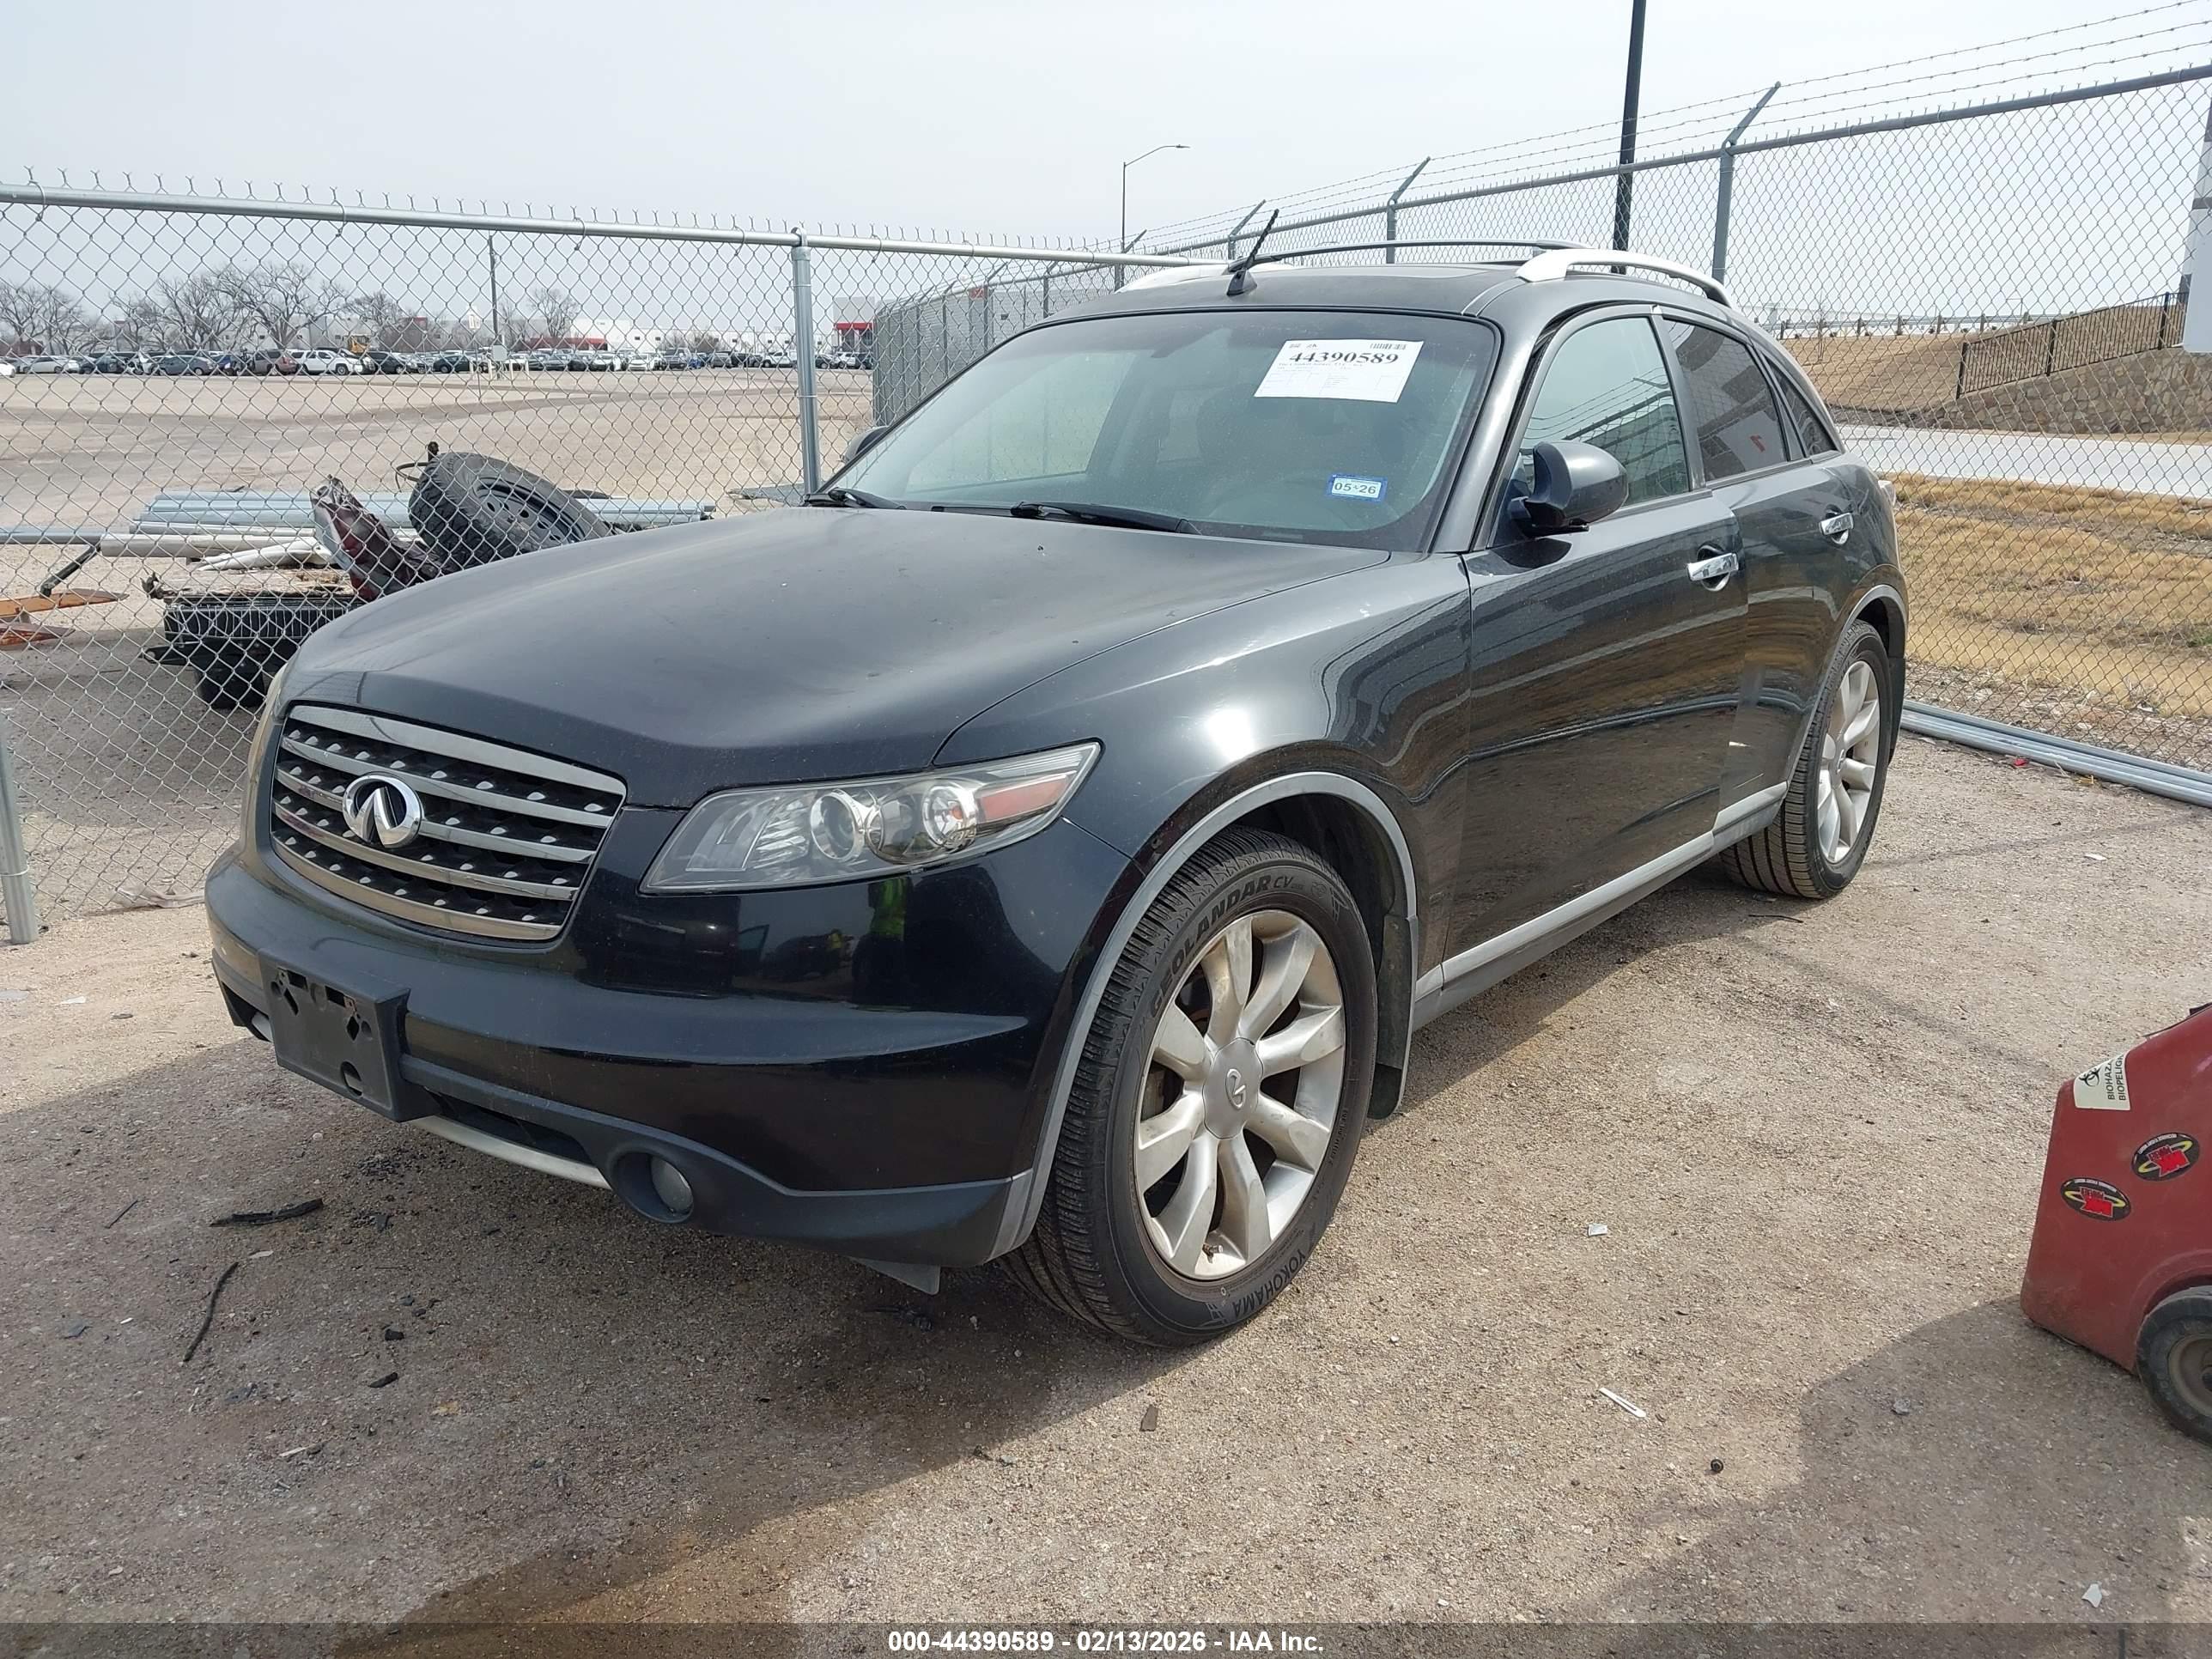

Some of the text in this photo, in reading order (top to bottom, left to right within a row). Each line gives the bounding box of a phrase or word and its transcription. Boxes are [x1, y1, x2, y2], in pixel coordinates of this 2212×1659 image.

[1289, 352, 1400, 365] 44390589
[1150, 874, 1294, 1018] GEOLANDAR CV
[1232, 1249, 1306, 1317] YOKOHAMA
